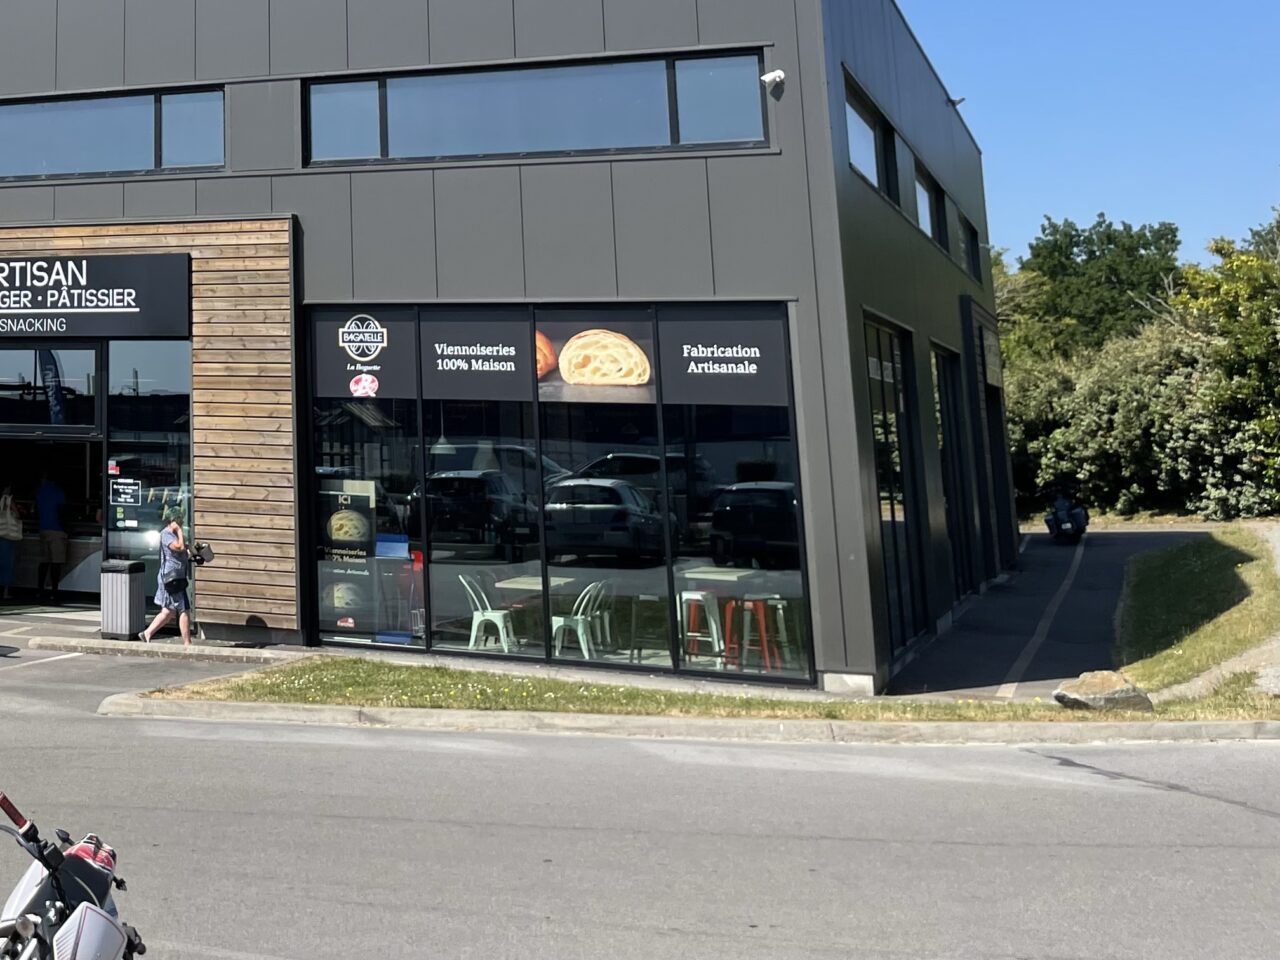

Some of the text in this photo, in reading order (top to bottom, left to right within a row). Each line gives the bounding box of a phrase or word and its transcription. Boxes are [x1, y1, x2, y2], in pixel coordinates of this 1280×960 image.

[46, 286, 136, 307] PÂTISSIER
[434, 343, 516, 356] Viennoiseries
[682, 344, 761, 358] Fabrication
[436, 358, 515, 371] 100% Maison
[687, 360, 758, 374] Artisanale
